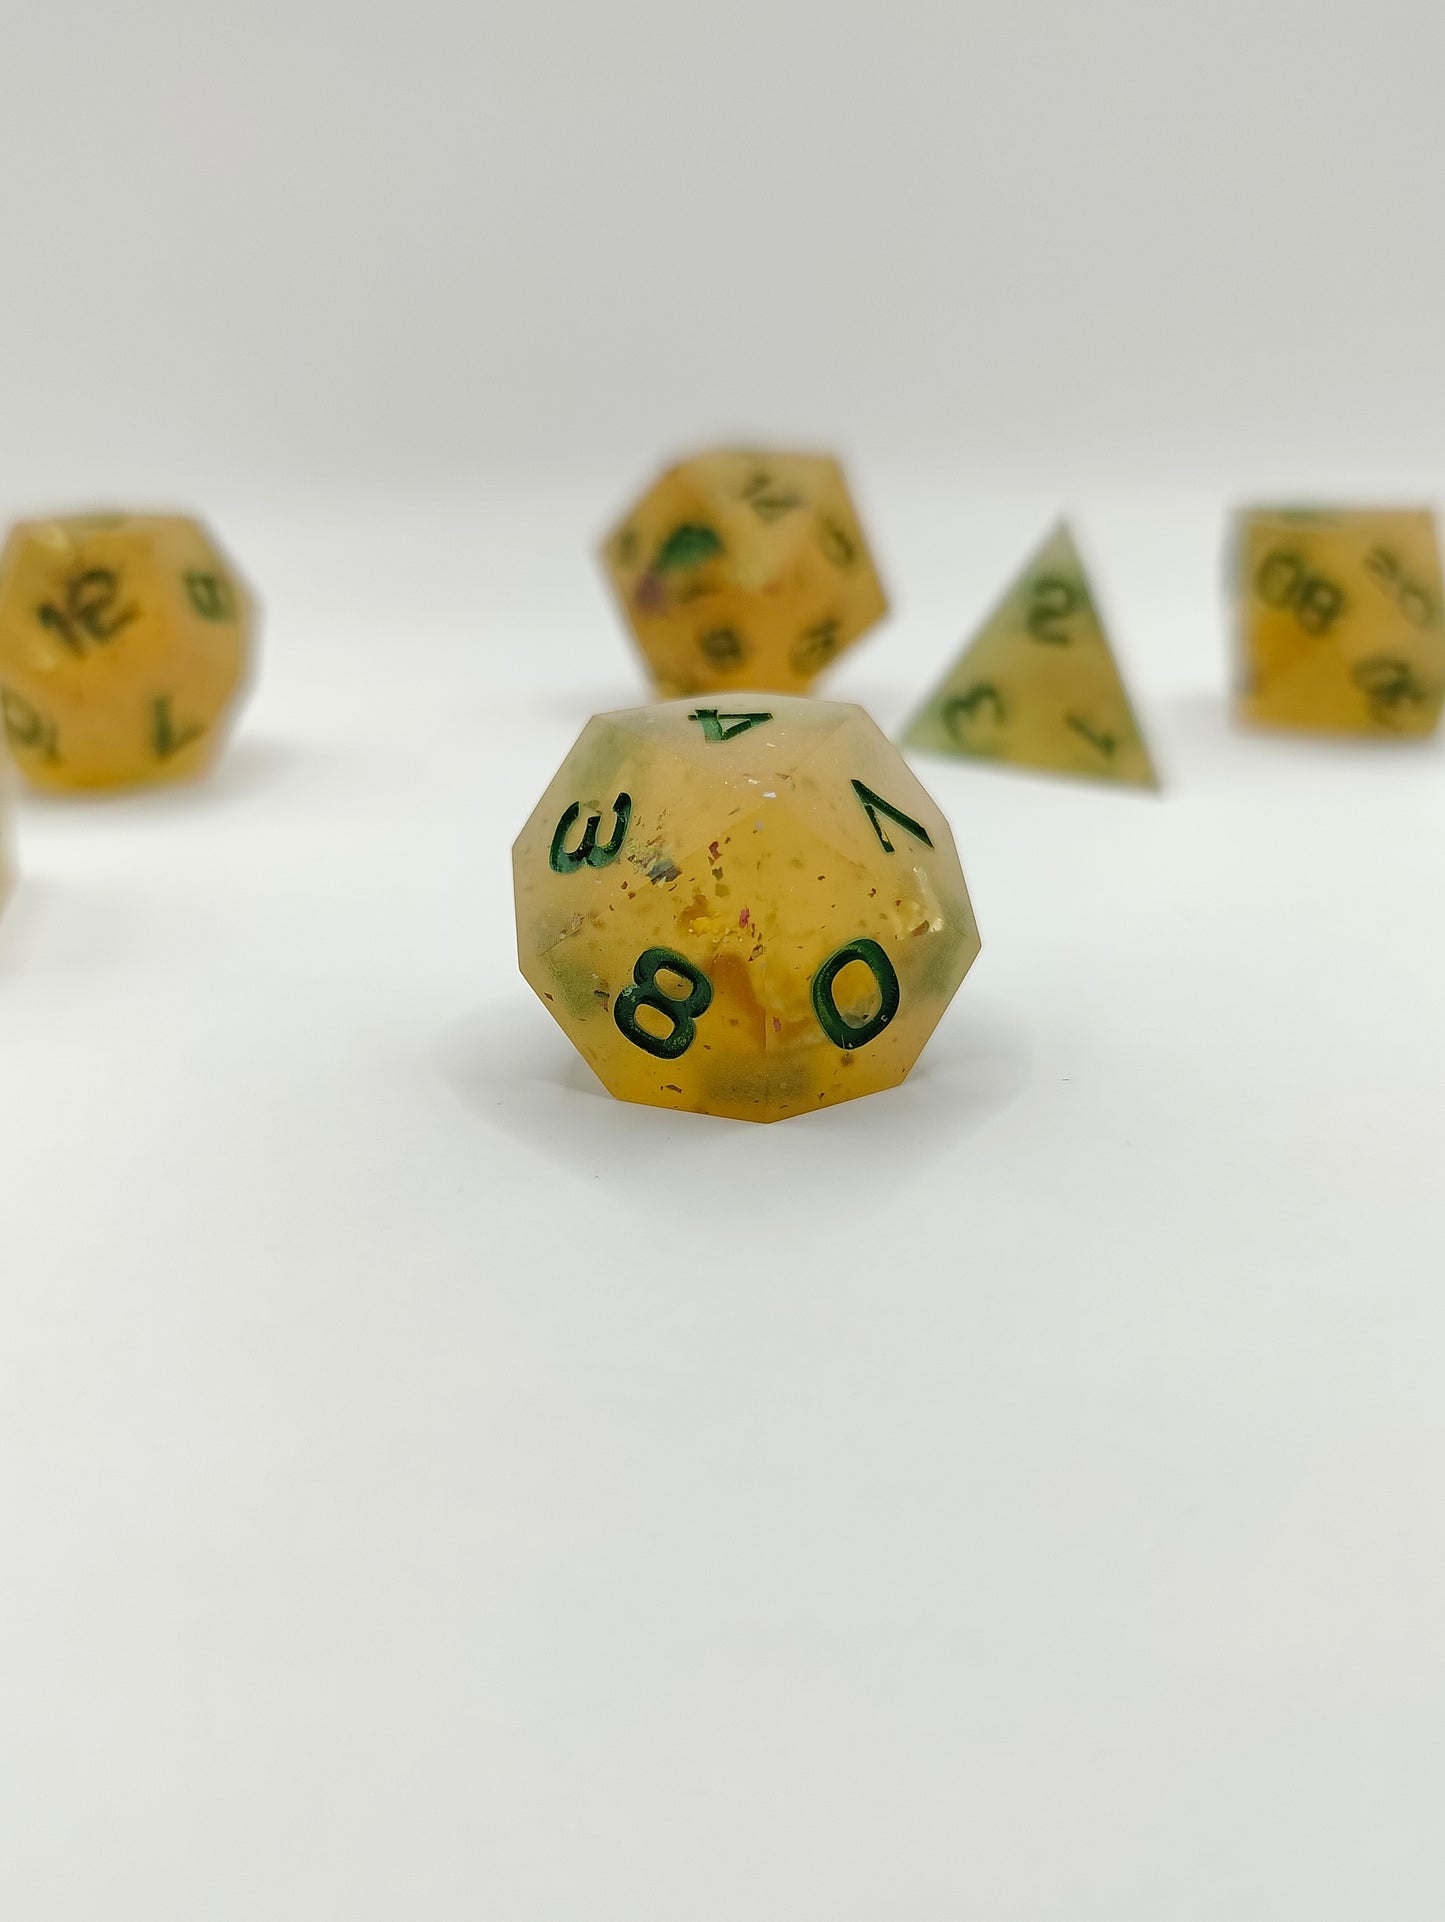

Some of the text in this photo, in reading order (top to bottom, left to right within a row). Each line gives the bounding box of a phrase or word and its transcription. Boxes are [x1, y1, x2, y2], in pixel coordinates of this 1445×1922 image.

[38, 565, 142, 657] 12
[1029, 577, 1085, 648] 2
[688, 708, 773, 743] 4
[943, 683, 1006, 740] 3
[549, 792, 632, 875] 3
[613, 946, 713, 1060] 8
[811, 938, 901, 1050] 0
